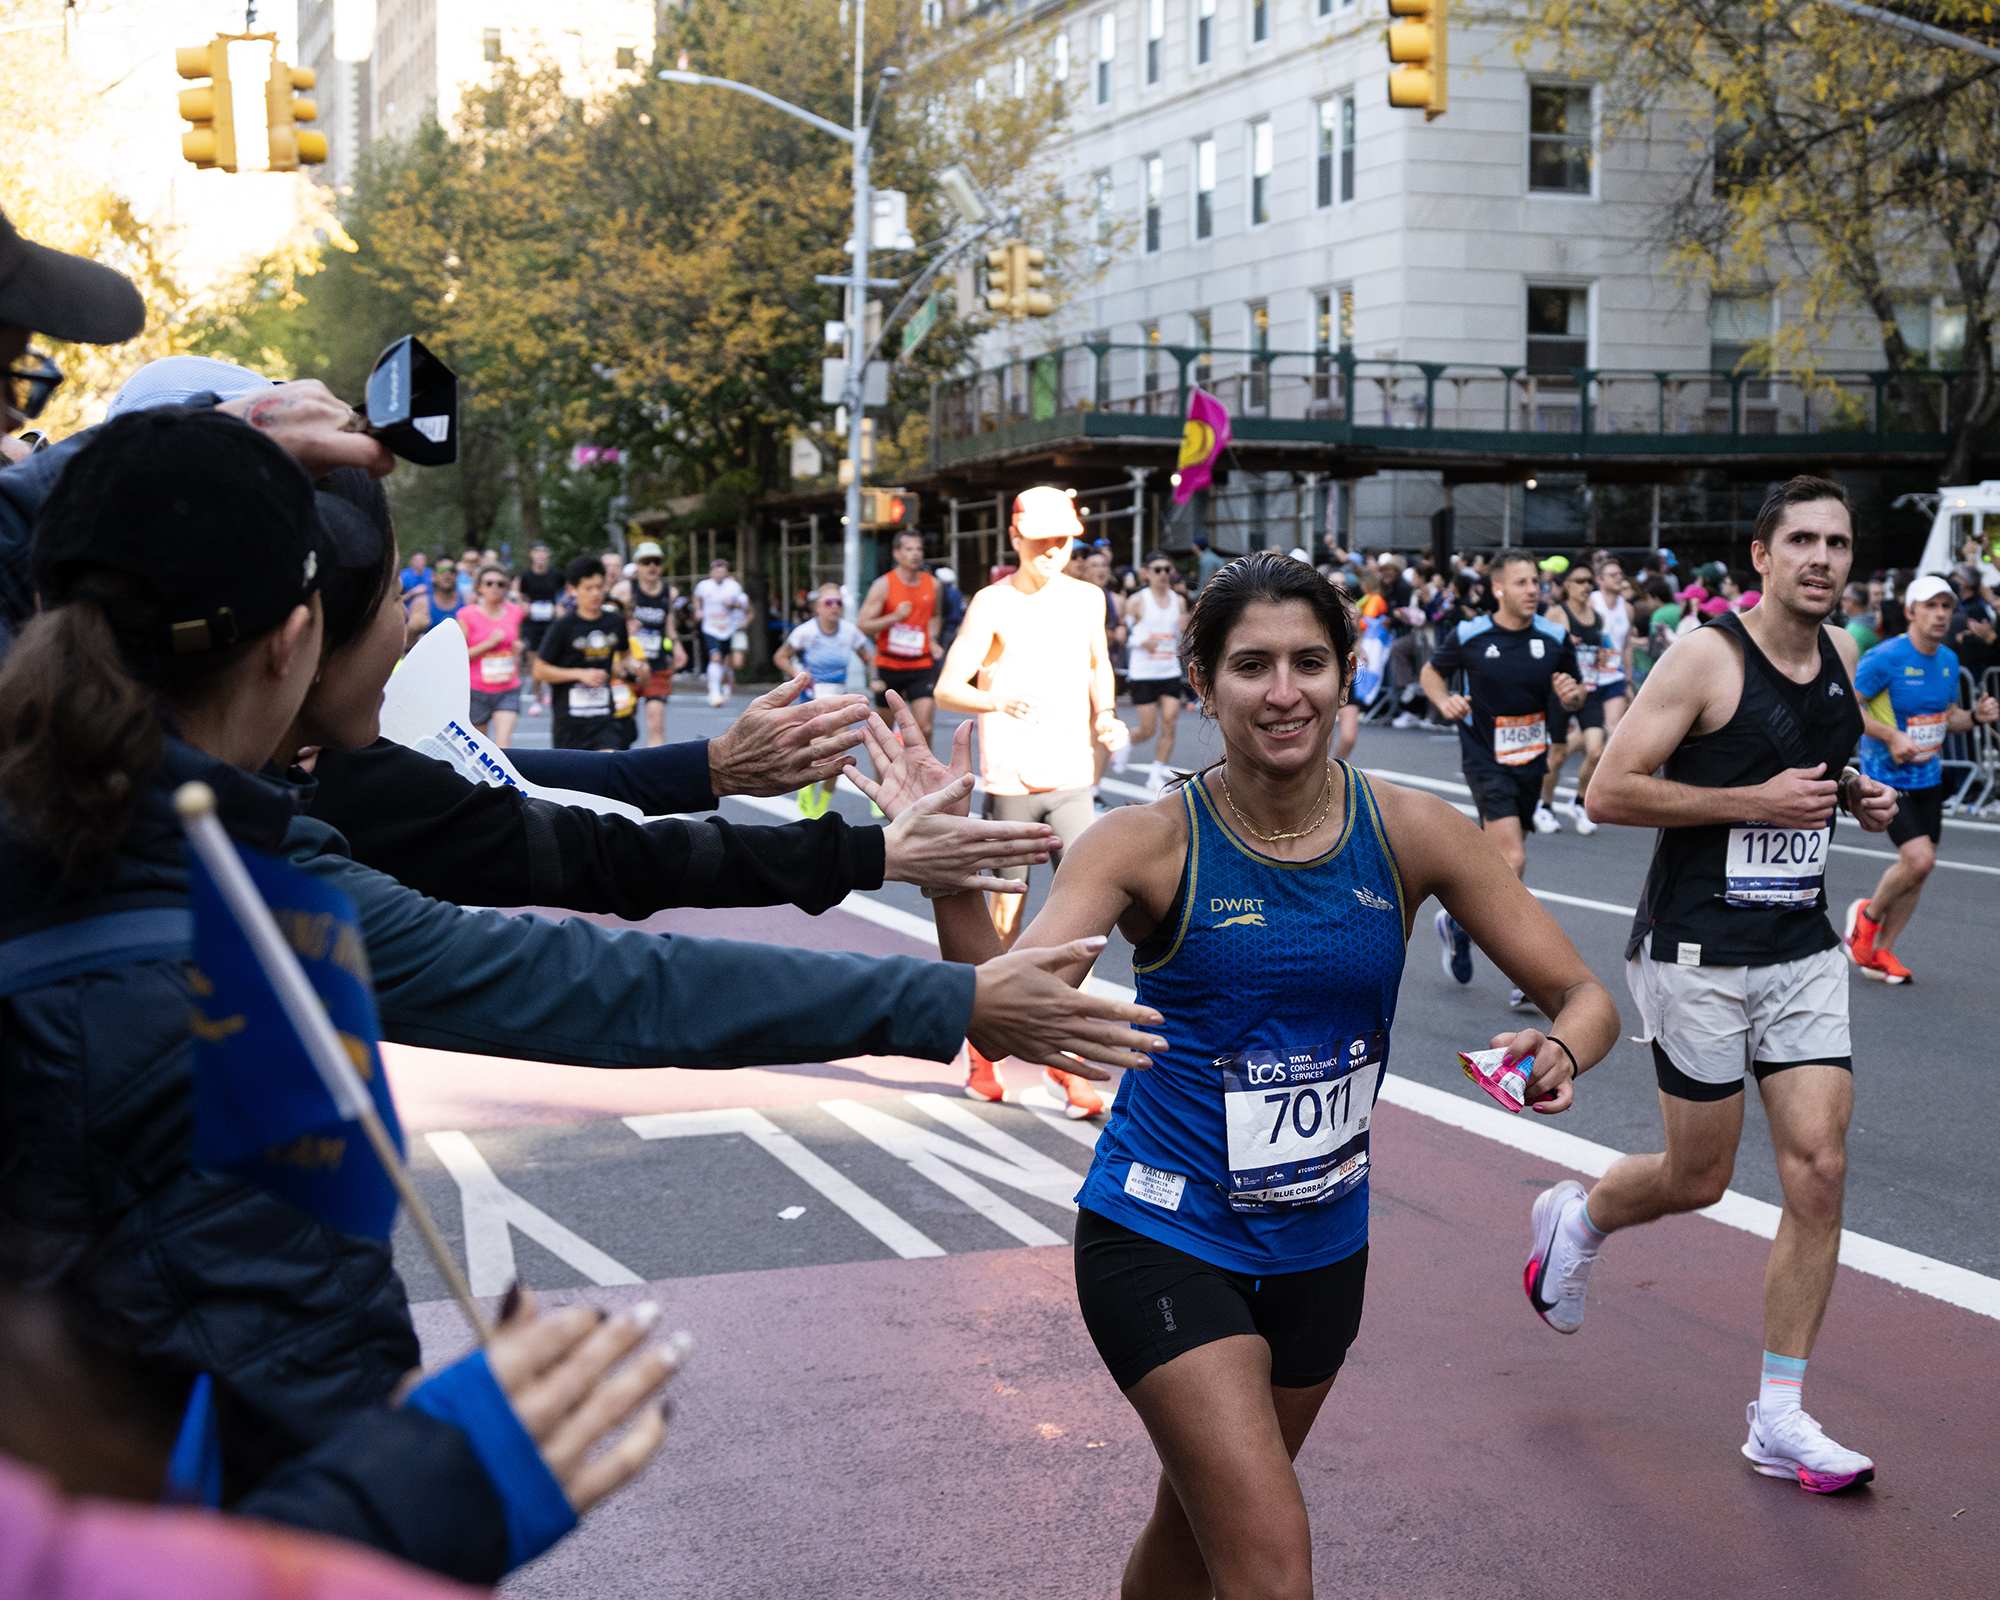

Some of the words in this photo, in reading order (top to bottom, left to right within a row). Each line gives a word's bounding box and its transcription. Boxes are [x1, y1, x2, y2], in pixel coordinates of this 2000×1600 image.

[443, 720, 480, 756] IT'S
[475, 752, 516, 786] NOT
[1743, 831, 1821, 865] 11202
[1210, 898, 1265, 912] DWRT
[1289, 1054, 1312, 1063] TATA
[1289, 1057, 1338, 1073] CONSULTANCY
[1349, 1055, 1368, 1069] TATA
[1247, 1060, 1287, 1085] tcs
[1290, 1070, 1324, 1081] SERVICES
[1264, 1076, 1352, 1145] 7011
[1141, 1165, 1177, 1183] BAKLINE
[1339, 1157, 1356, 1176] 2025
[1145, 1176, 1168, 1188] BROOKLYN
[1261, 1191, 1267, 1200] 1
[1274, 1189, 1295, 1198] BLUE
[1295, 1181, 1324, 1195] CORRAL
[1144, 1187, 1163, 1197] LONDON
[1161, 1308, 1178, 1332] janji
